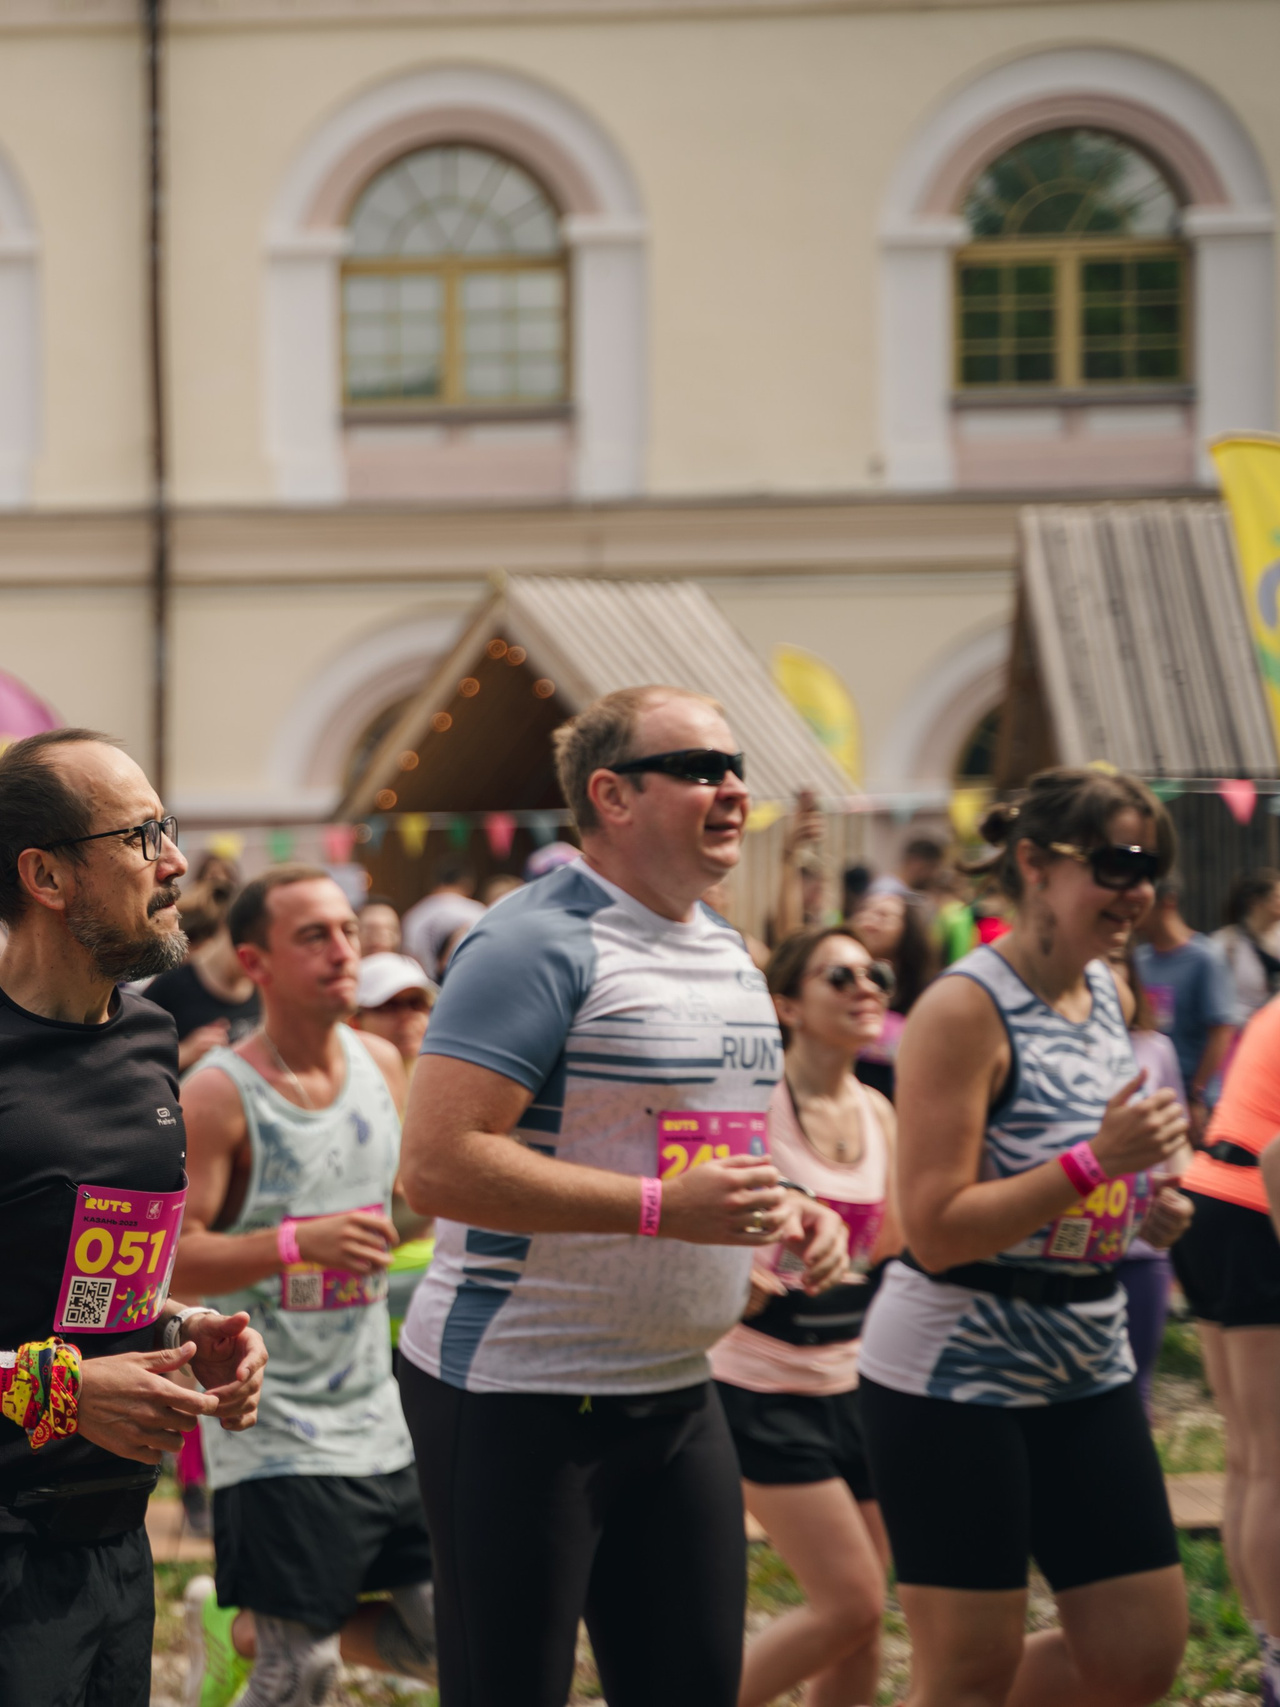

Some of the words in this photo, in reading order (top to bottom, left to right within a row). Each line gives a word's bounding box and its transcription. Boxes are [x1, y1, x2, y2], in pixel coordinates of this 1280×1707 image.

[722, 1035, 776, 1071] RUN
[84, 1197, 132, 1214] RUTS
[1065, 1179, 1128, 1219] 40
[82, 1216, 118, 1226] КАЗАНЬ
[74, 1227, 167, 1277] 051
